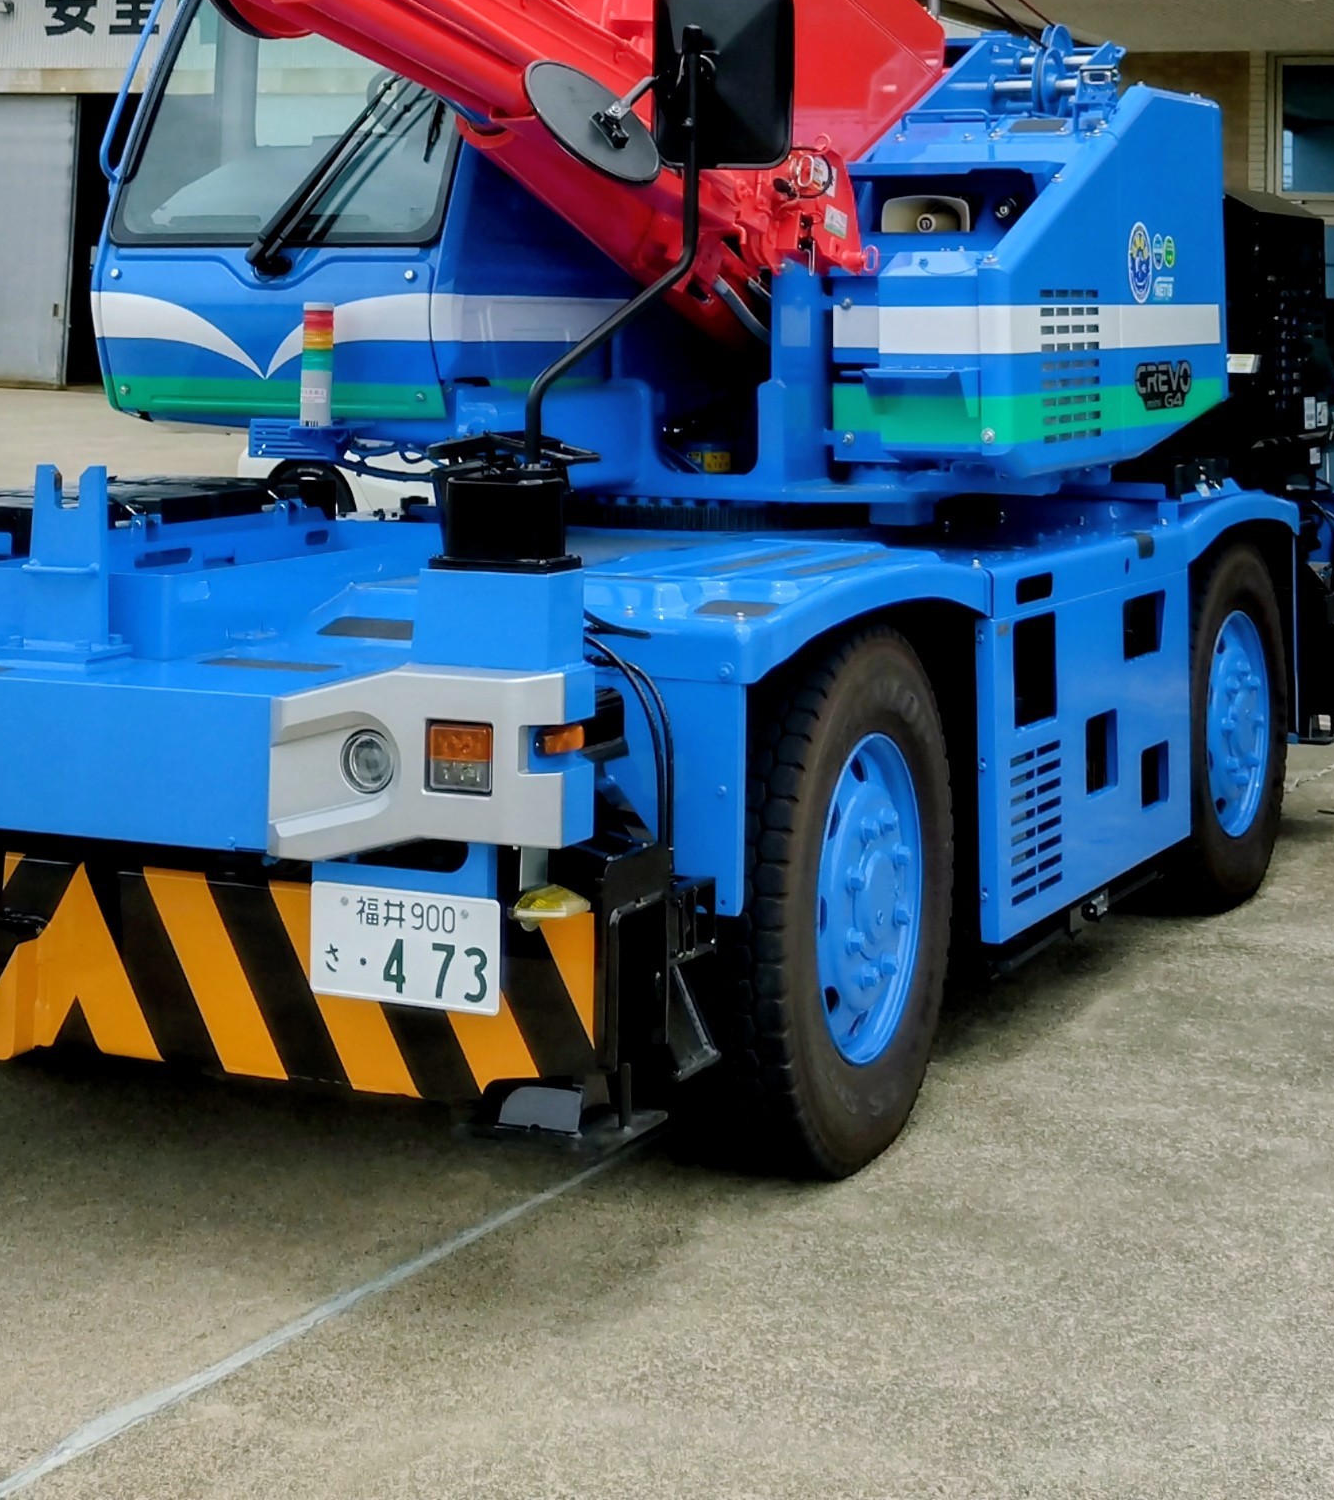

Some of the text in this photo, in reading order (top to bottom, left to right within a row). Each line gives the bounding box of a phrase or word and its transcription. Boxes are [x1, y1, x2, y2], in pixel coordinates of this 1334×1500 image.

[1136, 361, 1191, 394] CREVO
[1164, 392, 1183, 408] G4
[356, 896, 456, 934] 福井900
